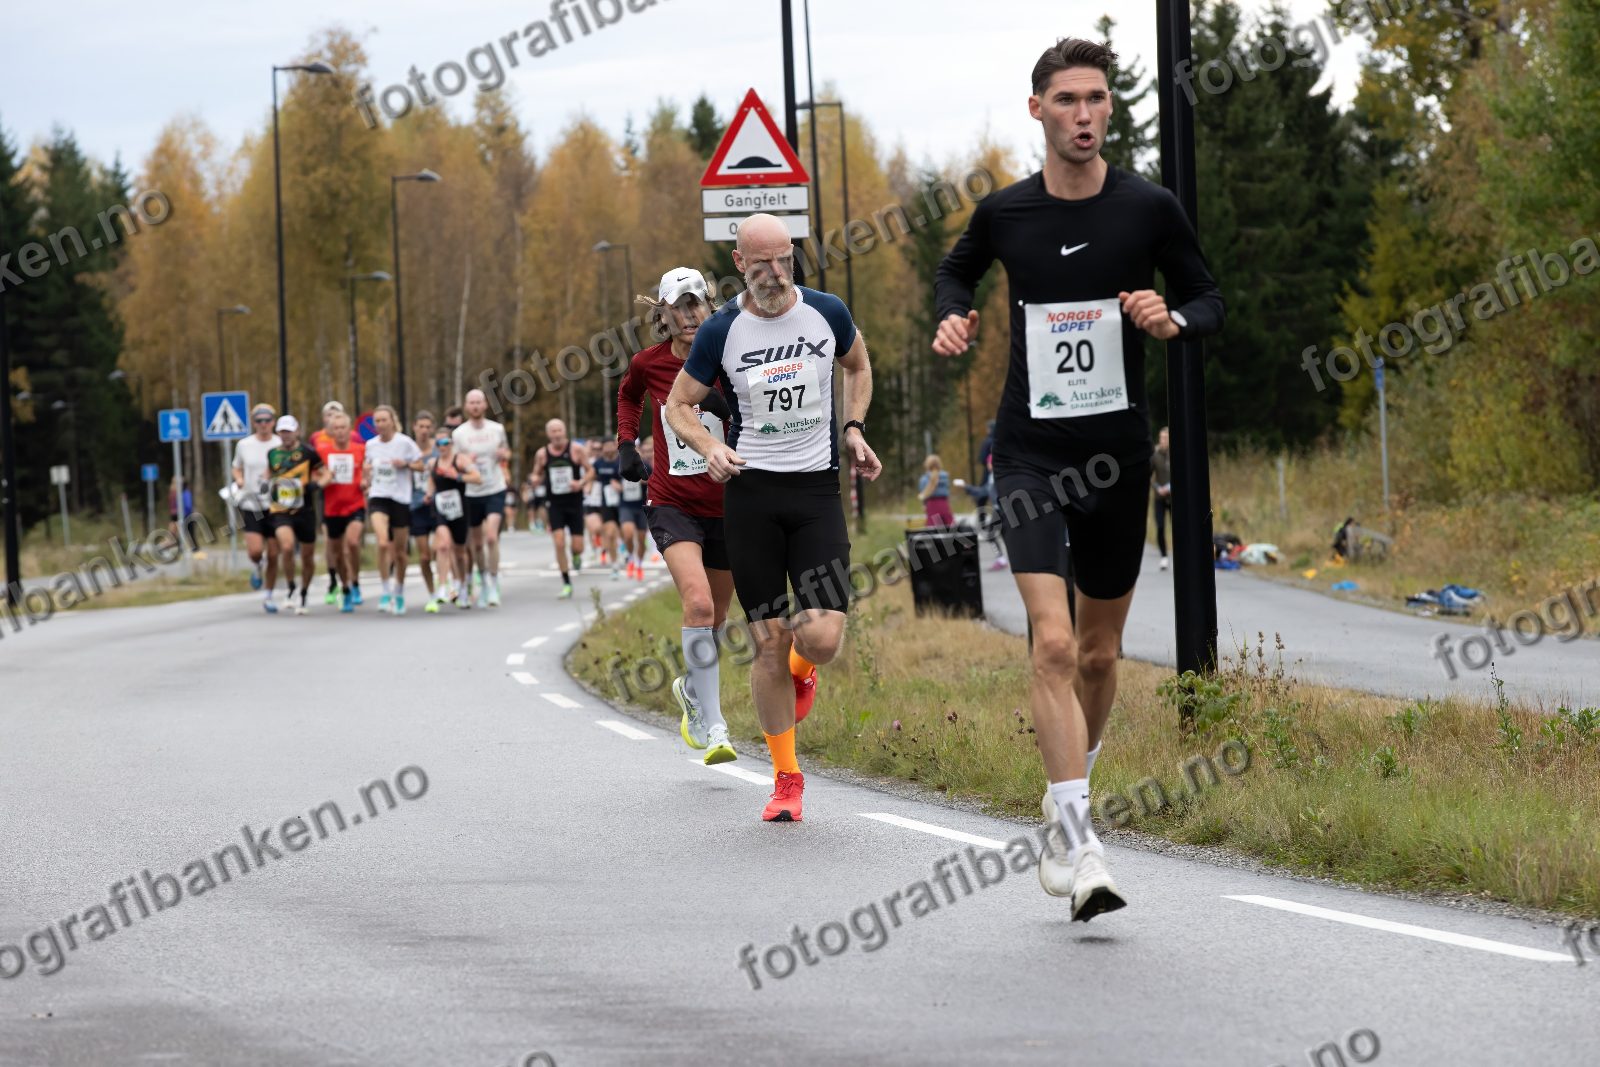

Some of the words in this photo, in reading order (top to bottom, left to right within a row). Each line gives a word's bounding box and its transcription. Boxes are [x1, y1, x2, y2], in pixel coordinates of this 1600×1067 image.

[725, 192, 787, 209] Gangfelt
[1047, 309, 1103, 322] NORGES
[1051, 320, 1094, 333] LØPET
[1055, 339, 1095, 374] 20
[762, 362, 804, 377] NORGES
[767, 371, 798, 384] LØPET
[763, 384, 806, 412] 797
[1070, 386, 1124, 403] Aurskog
[782, 416, 821, 430] Aurskog
